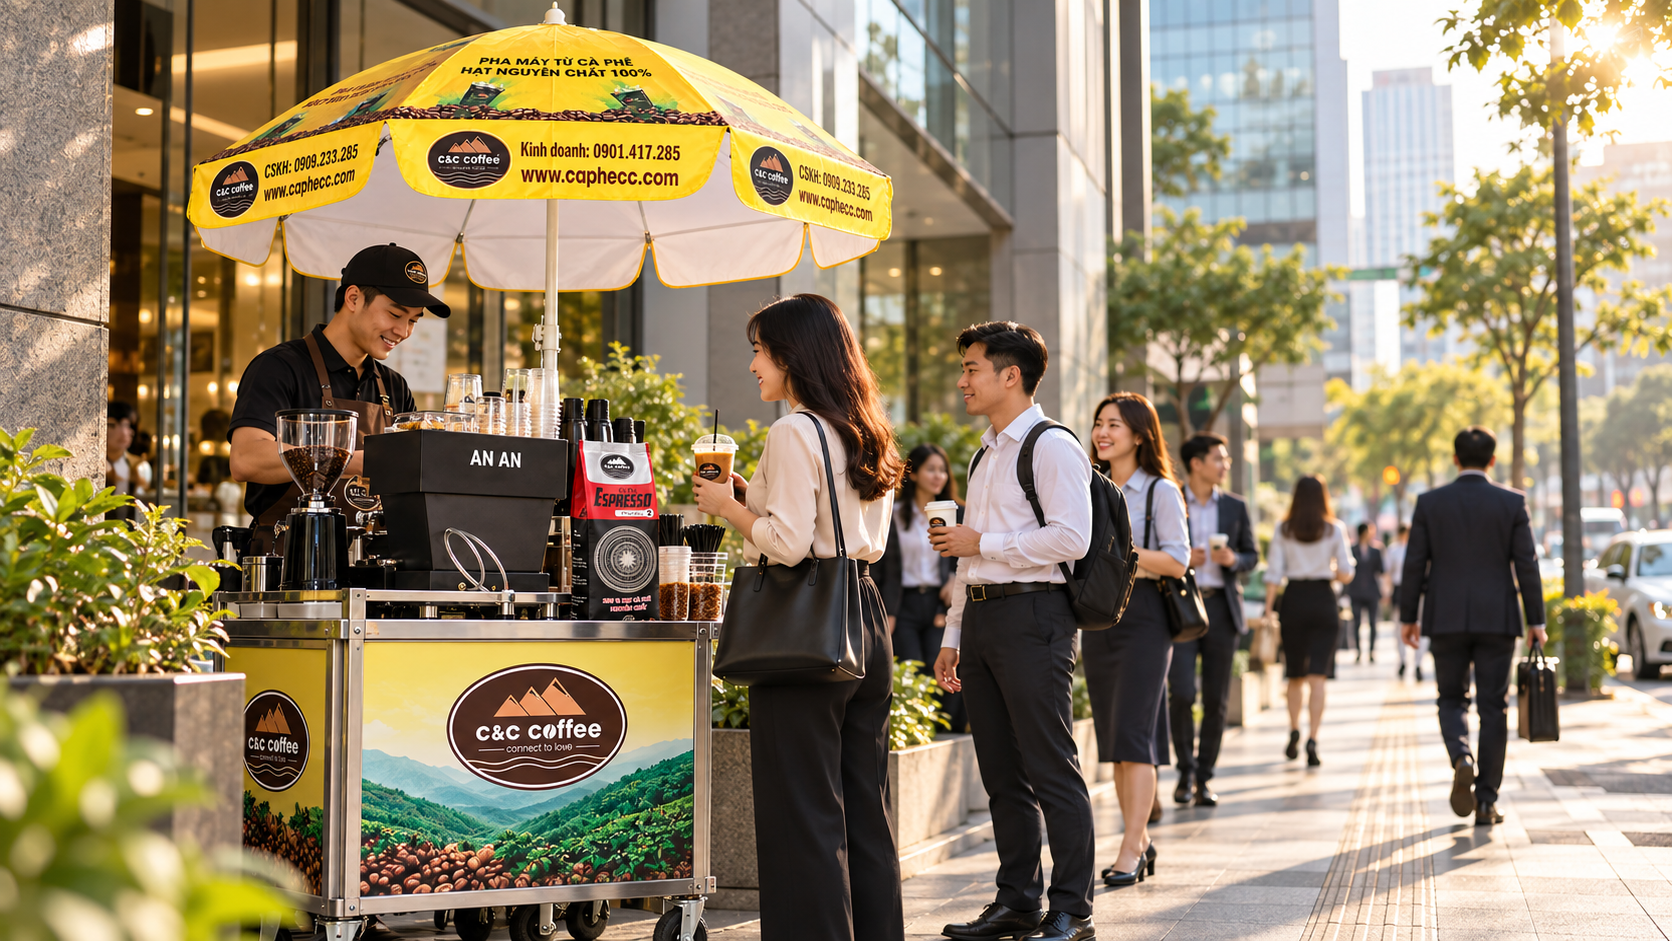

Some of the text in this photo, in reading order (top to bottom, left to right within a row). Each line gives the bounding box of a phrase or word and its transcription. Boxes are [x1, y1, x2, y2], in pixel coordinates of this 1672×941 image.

[479, 57, 511, 65] PHA
[515, 56, 550, 66] MÁY
[554, 56, 574, 66] TỪ
[577, 56, 600, 66] CÀ
[460, 67, 492, 77] HẠT
[496, 67, 560, 77] NGUYÊN
[610, 68, 652, 77] 100%
[264, 144, 359, 179] CSKH: 0909.233.285
[520, 141, 681, 161] Kinh doanh: 0901.417.285
[263, 169, 356, 202] www.caphecc.com
[520, 166, 679, 188] www.caphecc.com
[798, 164, 871, 201] CSKH: 0909.233.285
[798, 189, 873, 222] www.caphecc.com
[469, 449, 522, 469] AN AN
[527, 718, 602, 740] coffee
[267, 736, 299, 755] coffee
[505, 743, 542, 753] connect
[543, 743, 553, 752] to
